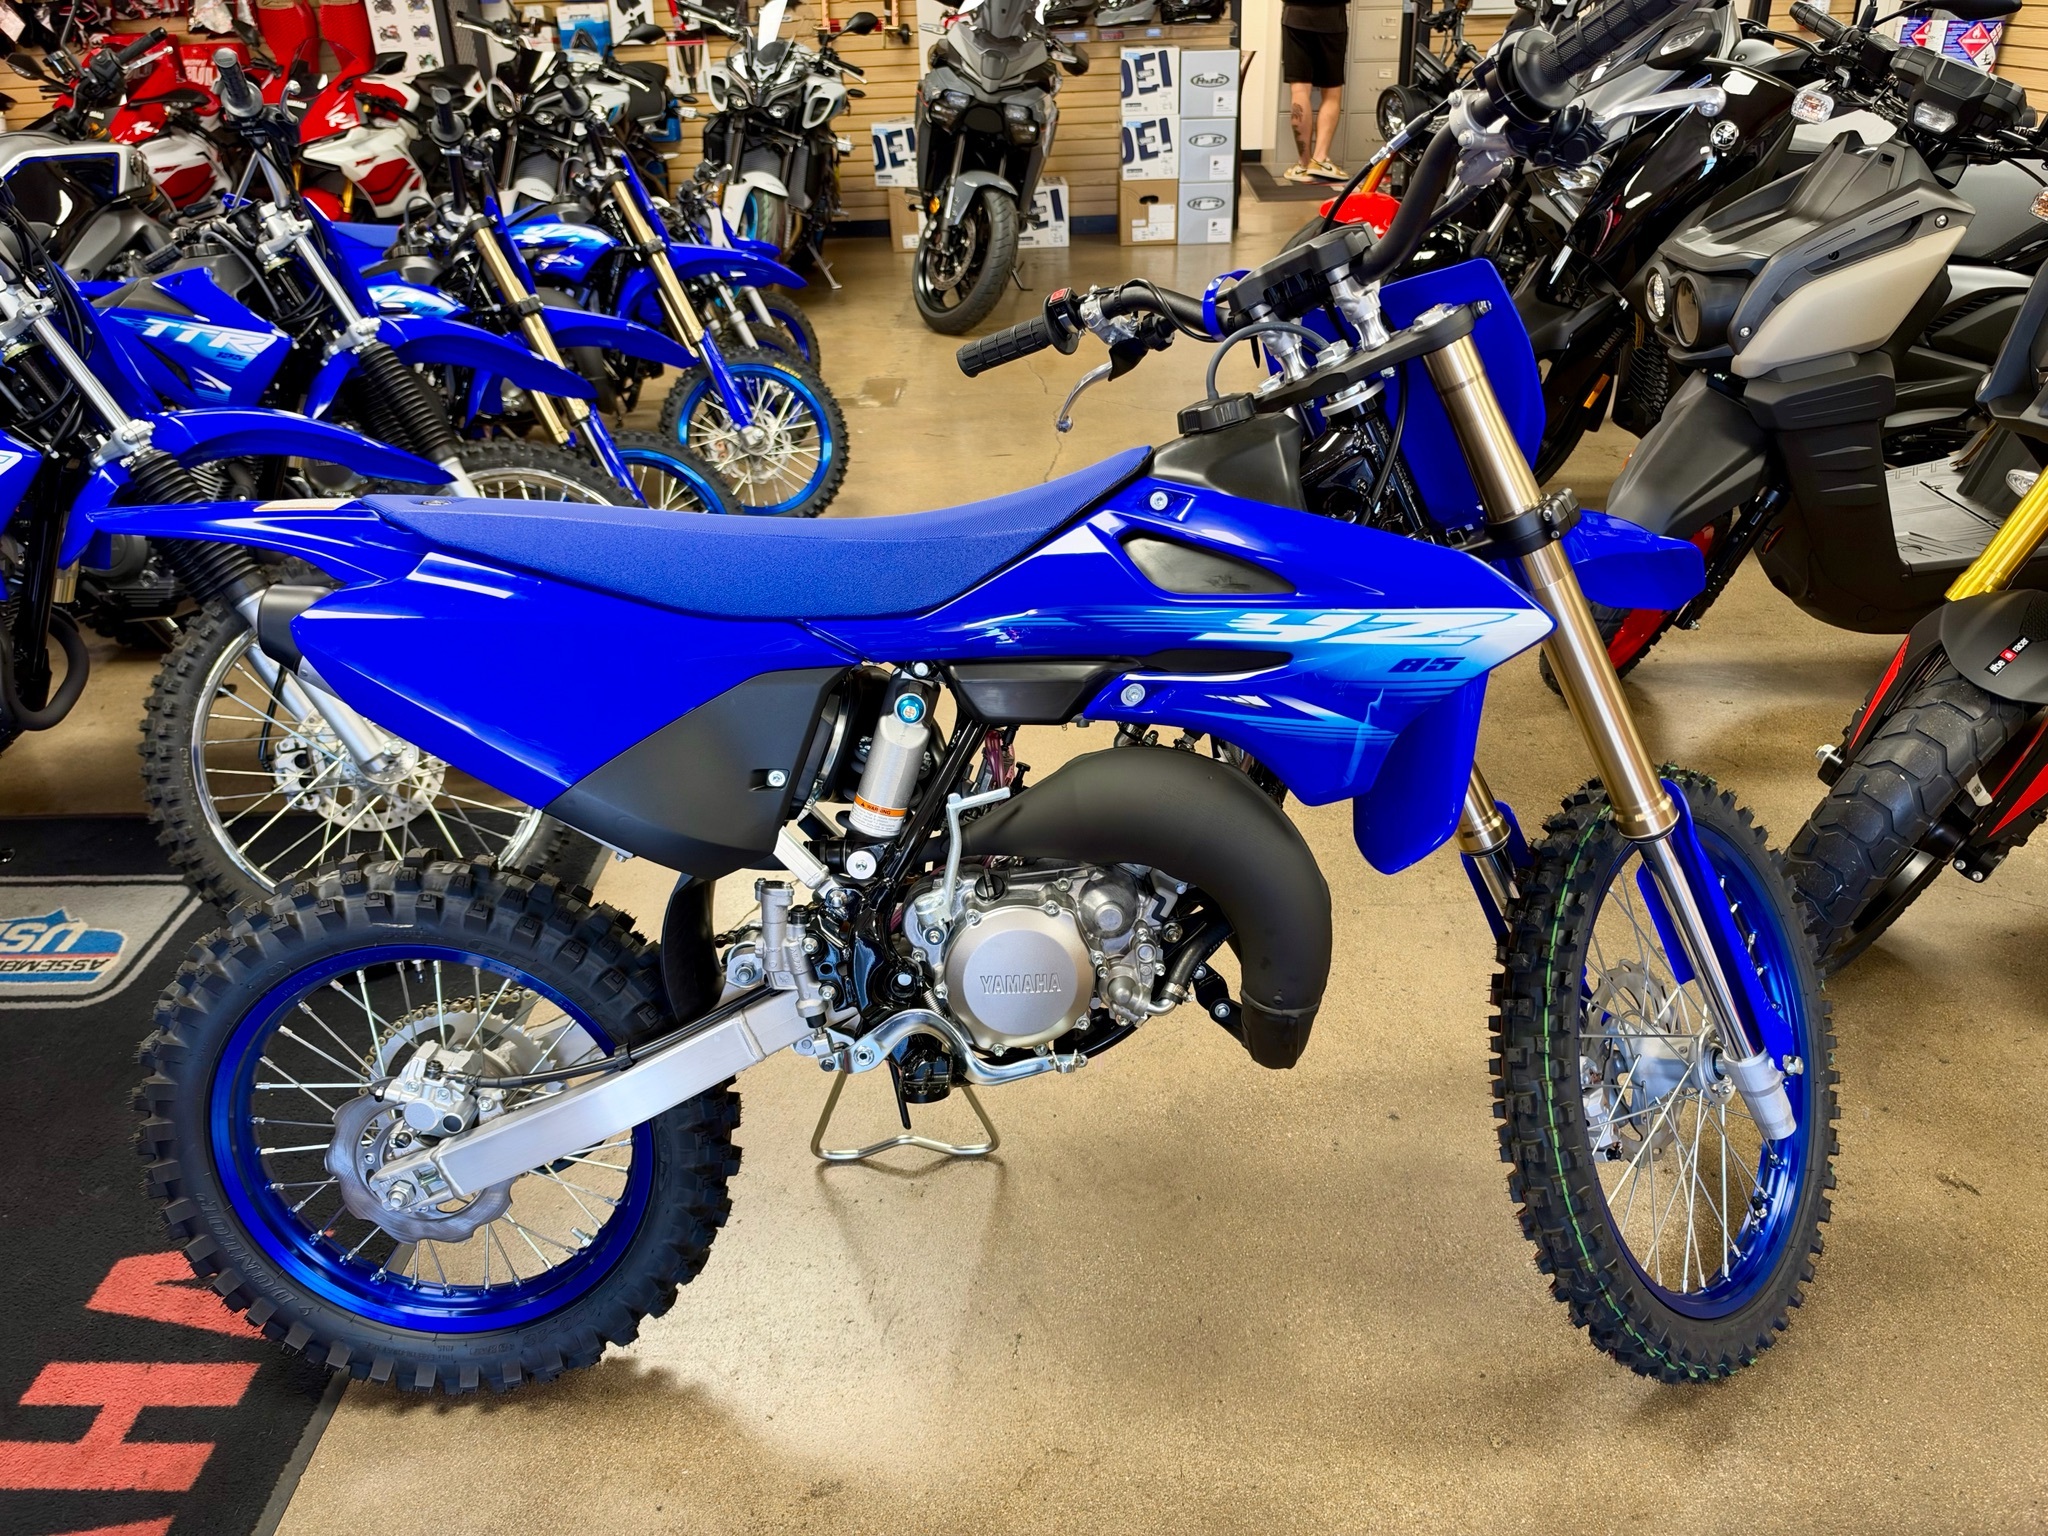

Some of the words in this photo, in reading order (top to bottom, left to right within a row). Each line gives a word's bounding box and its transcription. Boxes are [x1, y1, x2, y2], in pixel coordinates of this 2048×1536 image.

[142, 317, 271, 355] TTR
[1594, 327, 1624, 359] YAMAHA
[215, 351, 247, 362] 125
[1200, 612, 1518, 646] YZ
[1387, 656, 1466, 674] 85
[1989, 659, 2006, 674] #be
[2012, 637, 2030, 653] racer
[867, 803, 891, 816] WARING
[0, 921, 89, 953] US
[0, 958, 111, 973] ASSEMB
[979, 972, 1062, 995] YAMAHA
[195, 1192, 299, 1307] DUNLOP
